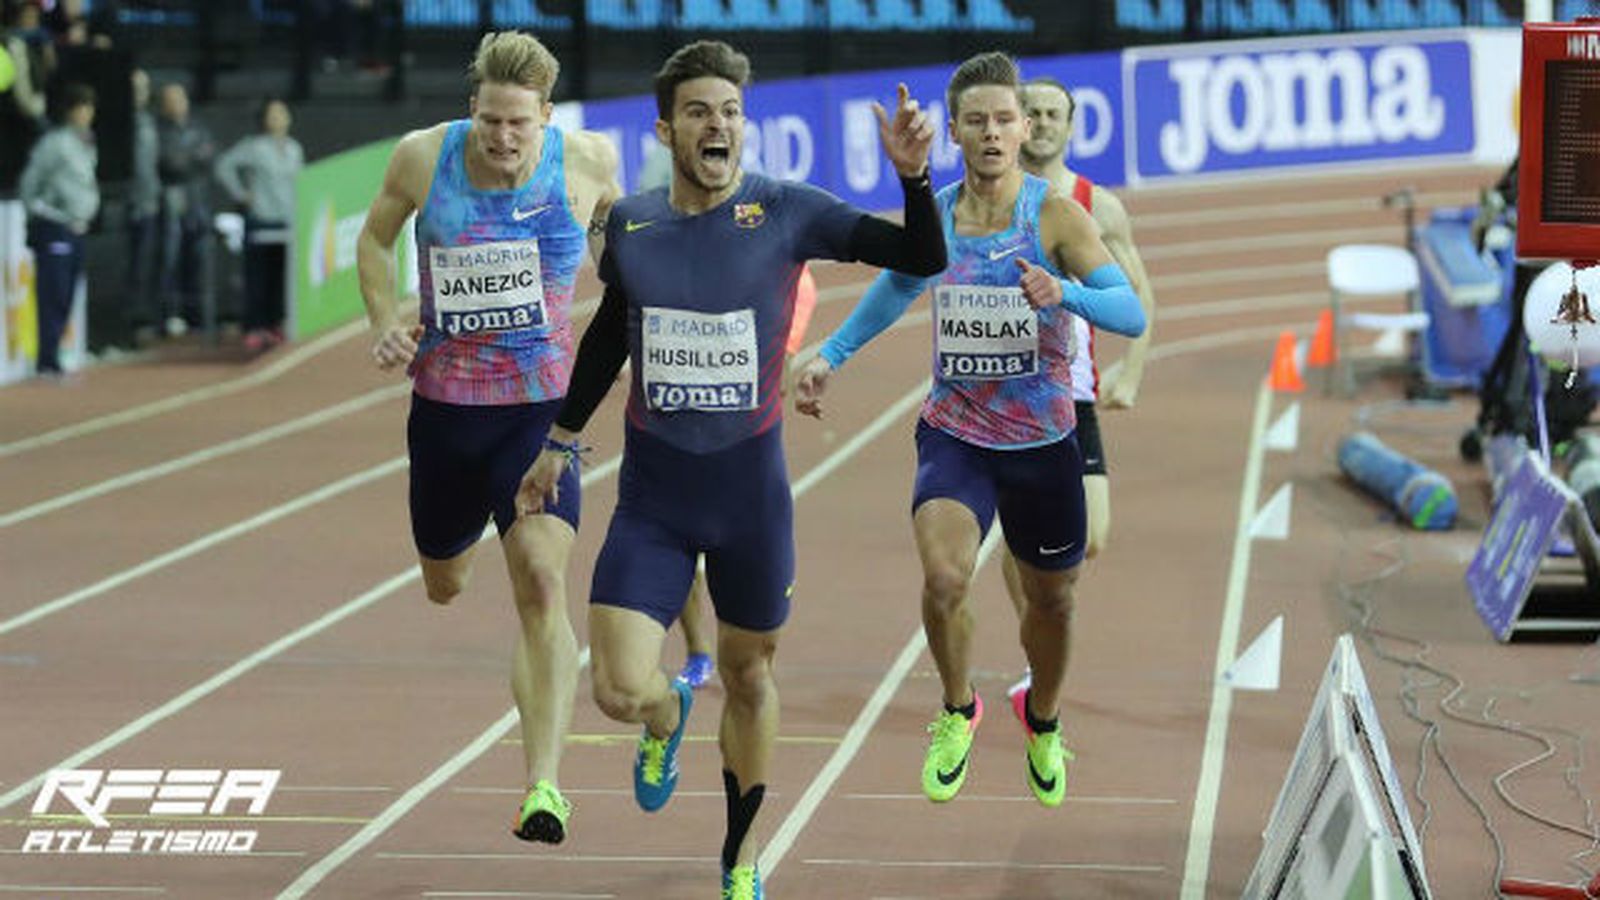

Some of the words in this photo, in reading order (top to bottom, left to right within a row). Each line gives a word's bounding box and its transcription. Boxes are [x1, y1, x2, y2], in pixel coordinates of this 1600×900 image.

[458, 247, 534, 267] MADRID
[440, 269, 534, 296] JANEZIC
[670, 319, 748, 336] MADRID
[940, 319, 1031, 339] MASLAK
[648, 349, 749, 369] HUSILLOS
